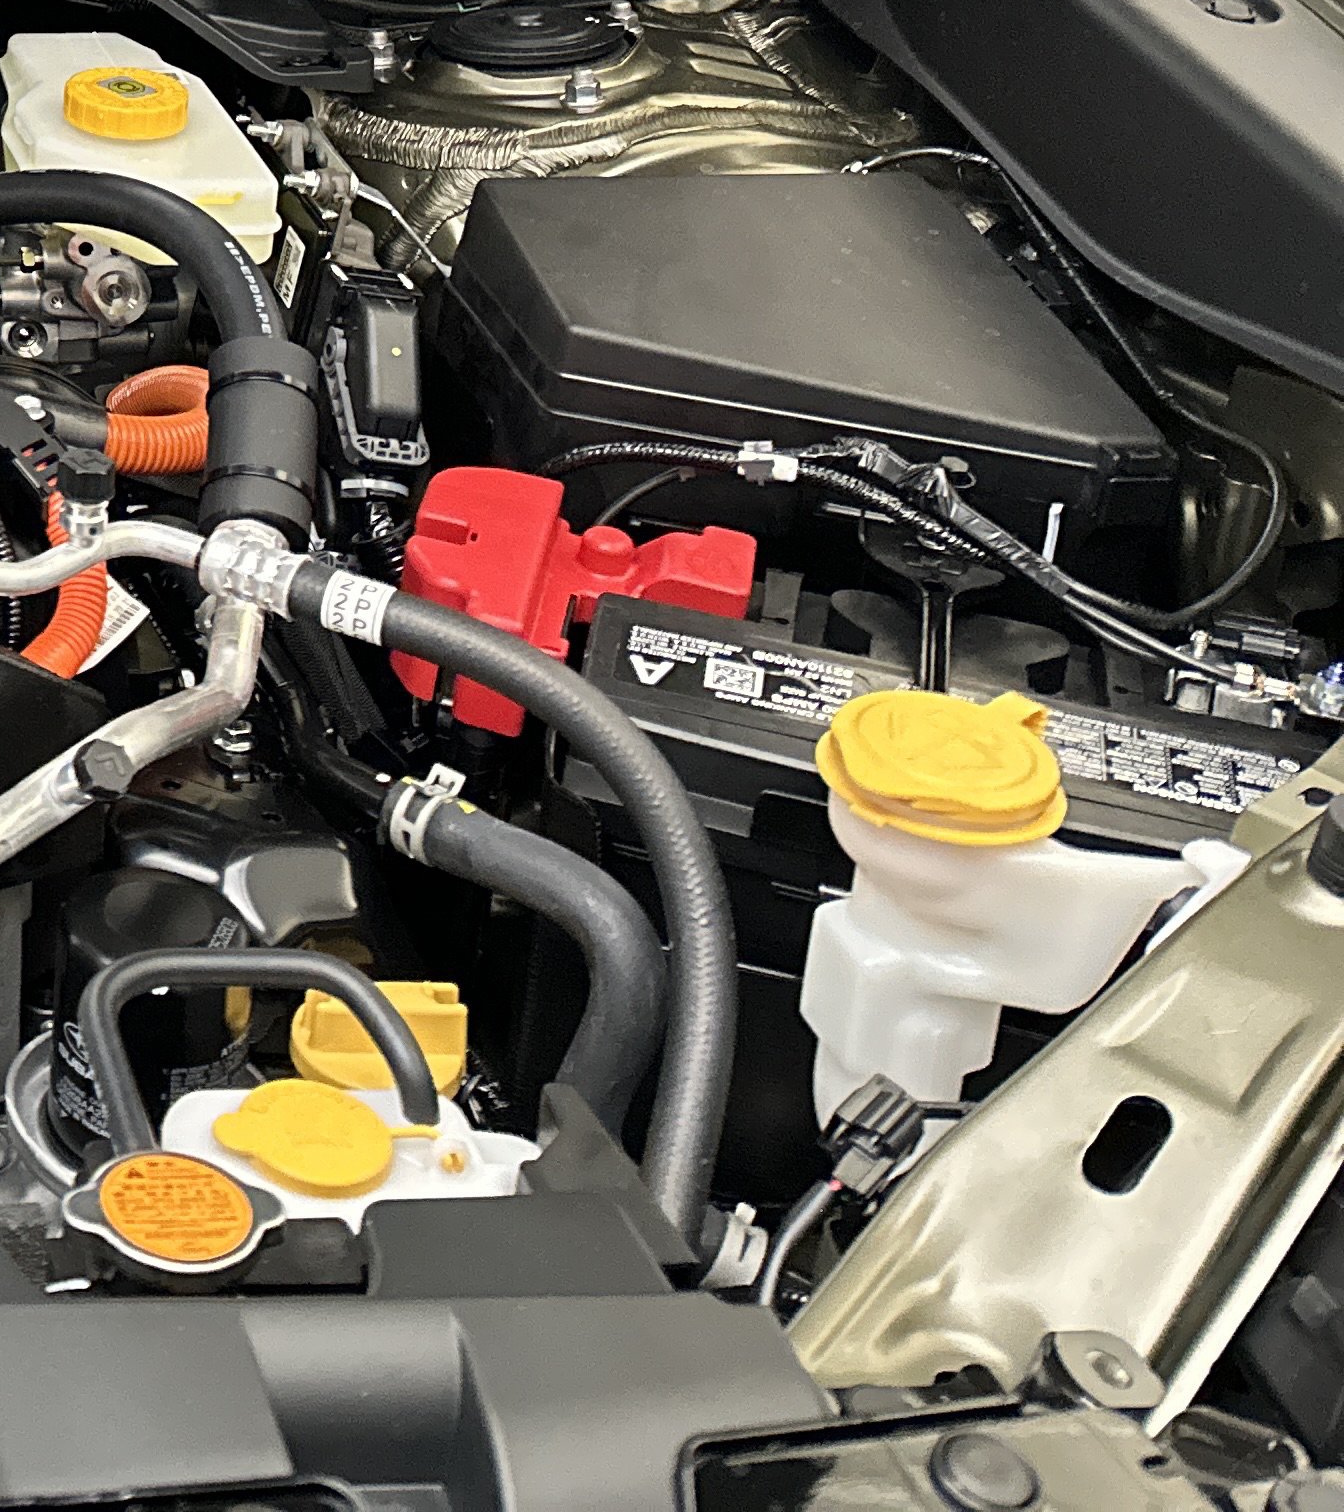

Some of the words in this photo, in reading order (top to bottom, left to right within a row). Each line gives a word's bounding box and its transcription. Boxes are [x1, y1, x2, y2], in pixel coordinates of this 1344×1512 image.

[629, 655, 676, 686] A
[819, 685, 852, 698] LN2
[771, 694, 819, 710] AMPS
